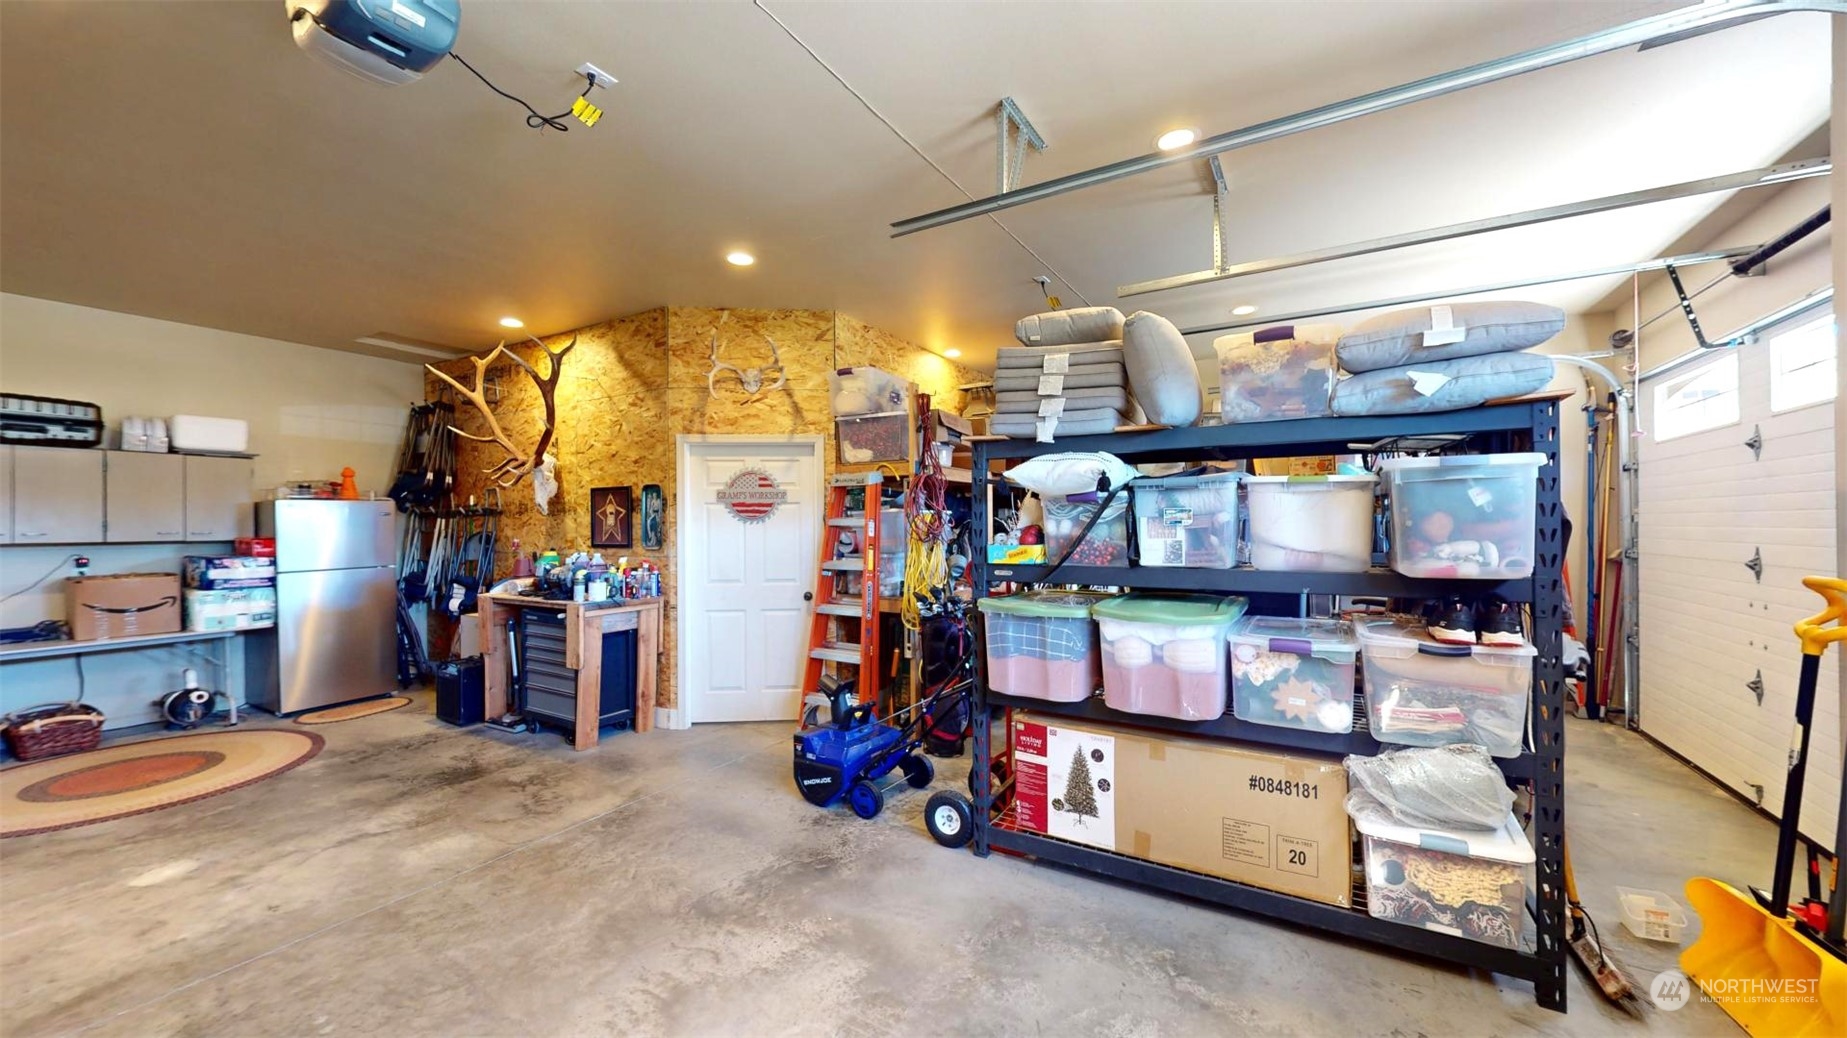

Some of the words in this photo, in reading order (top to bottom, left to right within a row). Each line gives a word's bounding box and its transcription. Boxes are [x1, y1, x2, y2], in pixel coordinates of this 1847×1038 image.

[748, 491, 787, 500] WORKSHOP
[1249, 775, 1317, 799] #0848181
[1289, 849, 1306, 866] 20
